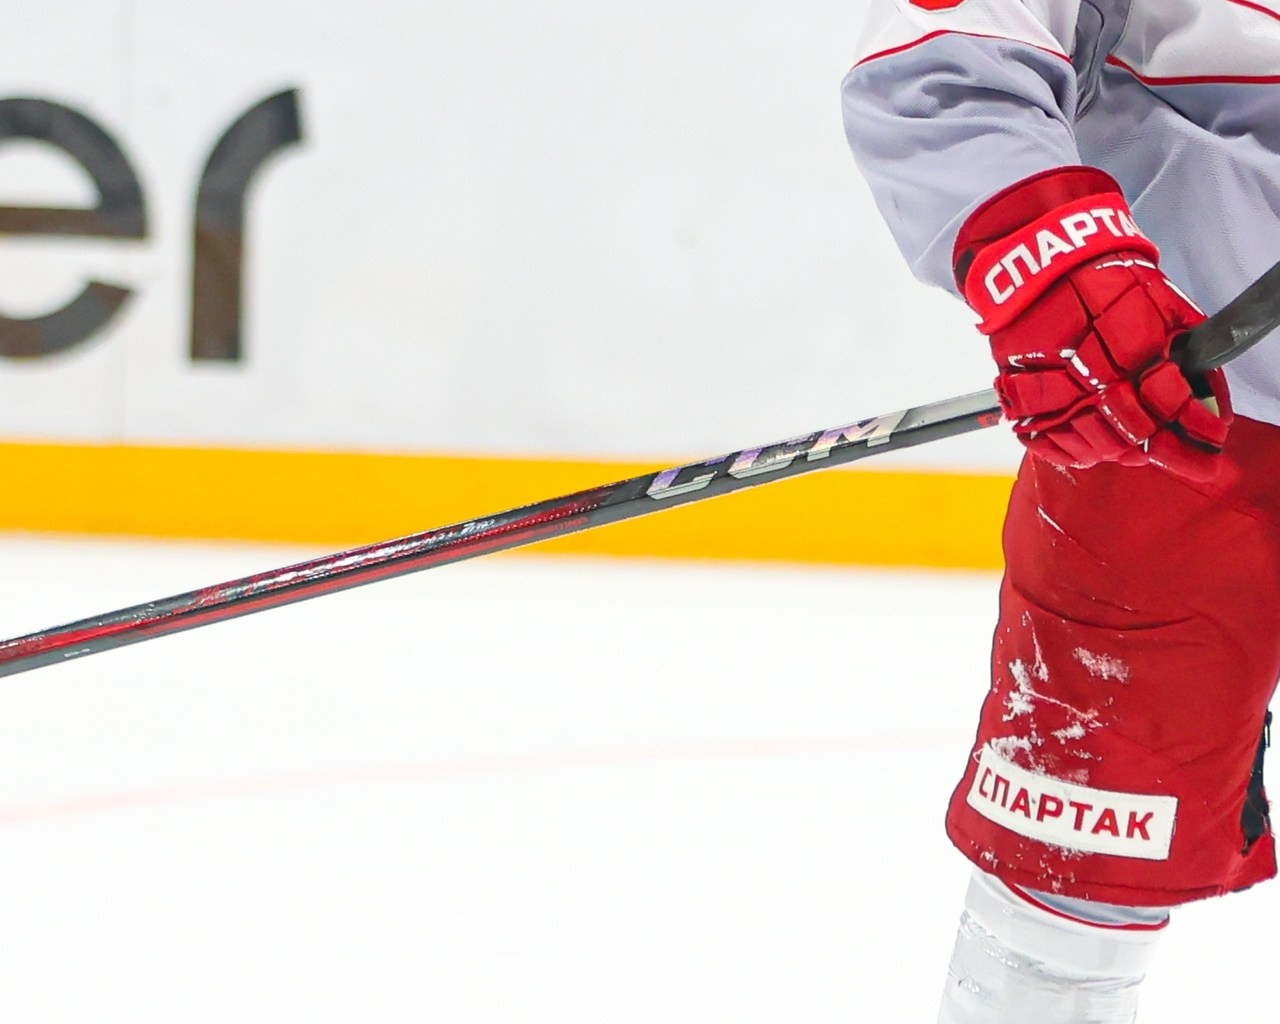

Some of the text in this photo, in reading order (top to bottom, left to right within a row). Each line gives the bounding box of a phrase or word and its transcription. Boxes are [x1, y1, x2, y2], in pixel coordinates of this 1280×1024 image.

[0, 87, 305, 361] er
[984, 207, 1145, 305] СПАРТА
[646, 408, 910, 500] CCM
[978, 767, 1154, 841] СПАРТАК
